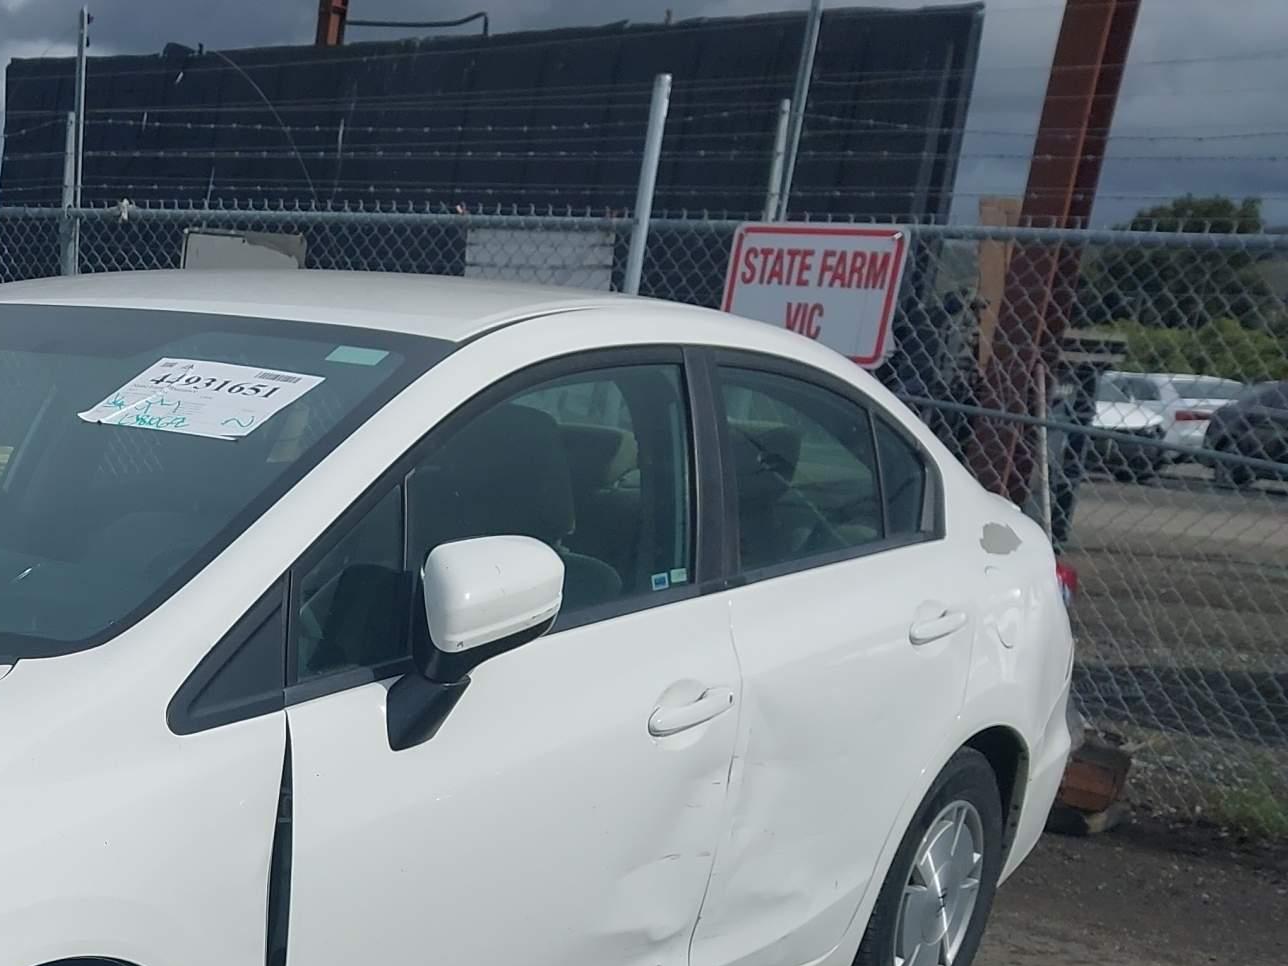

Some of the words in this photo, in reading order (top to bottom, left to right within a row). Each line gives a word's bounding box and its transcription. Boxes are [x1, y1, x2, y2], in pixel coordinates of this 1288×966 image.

[741, 247, 815, 287] STATE
[817, 248, 891, 289] FARM
[785, 302, 824, 340] VIC
[150, 372, 280, 398] 44931651
